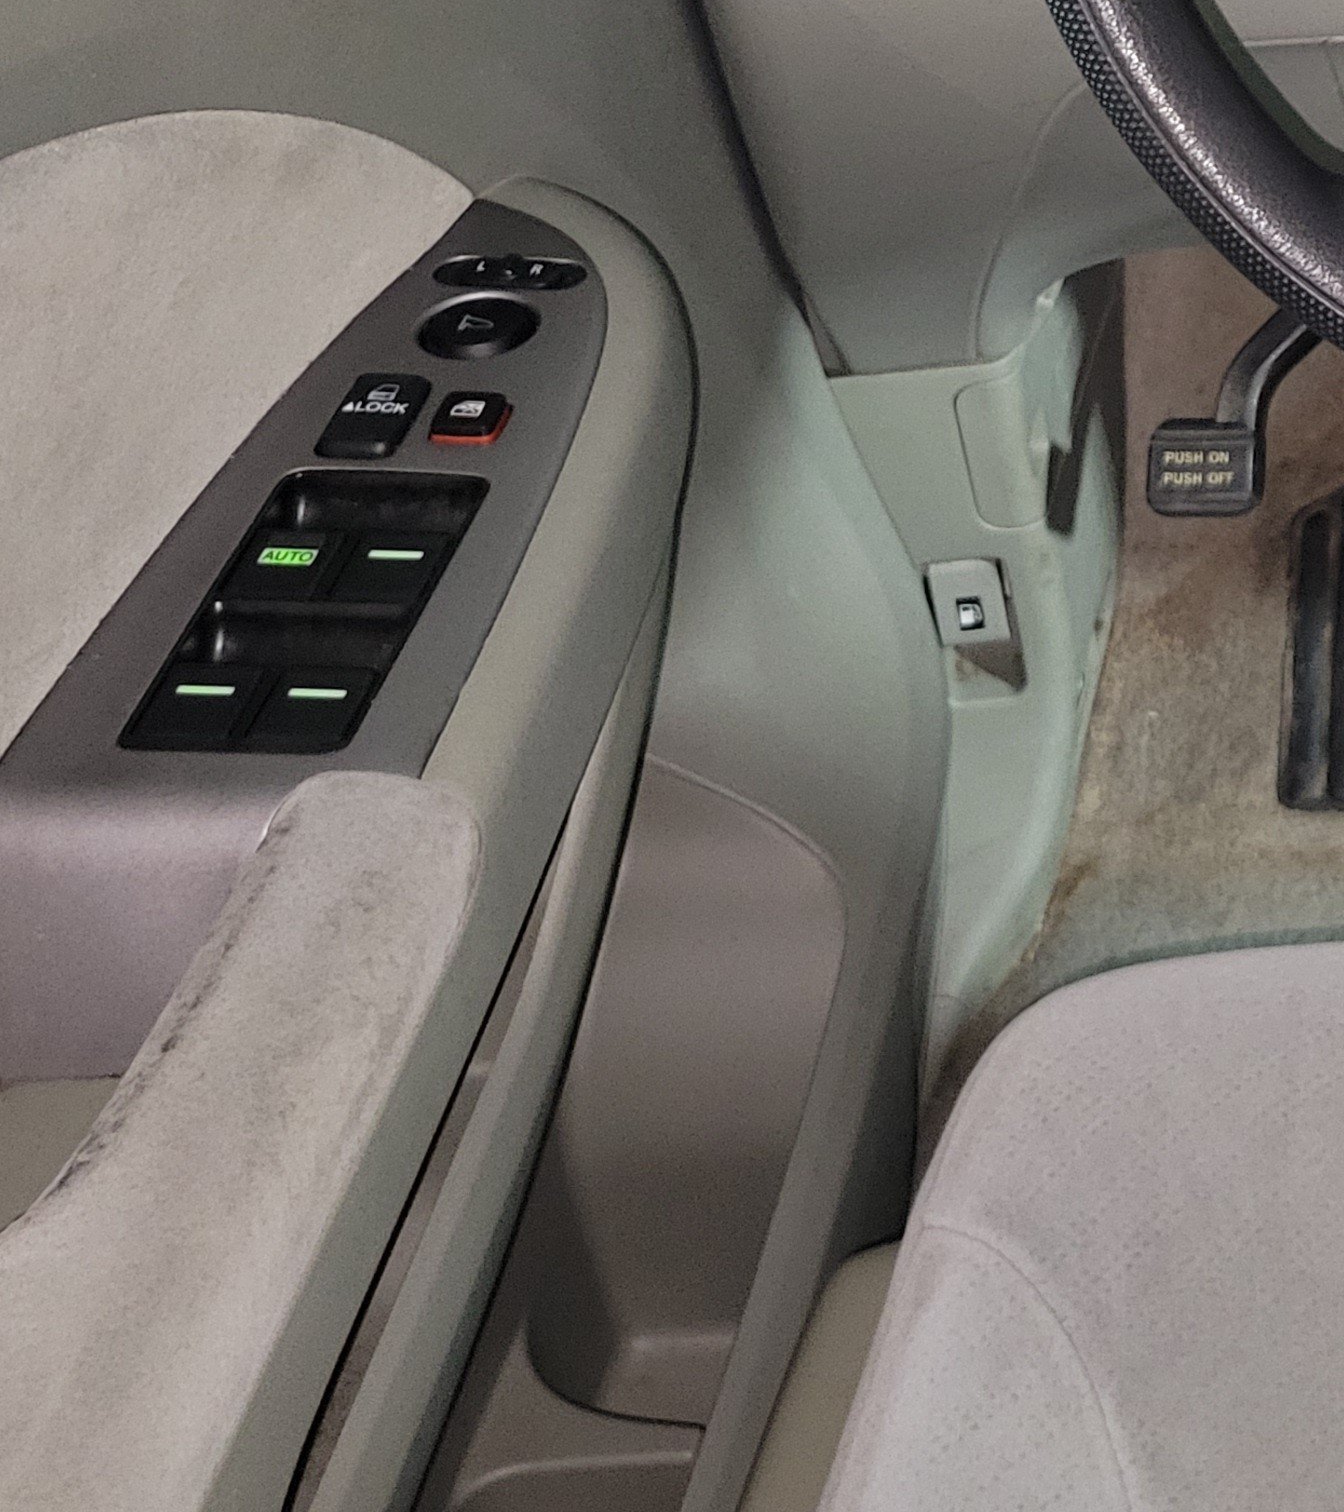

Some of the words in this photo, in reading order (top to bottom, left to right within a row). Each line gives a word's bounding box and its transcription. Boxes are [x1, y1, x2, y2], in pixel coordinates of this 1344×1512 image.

[475, 260, 485, 272] L
[529, 263, 544, 276] R
[353, 399, 409, 416] LOCK
[1163, 450, 1204, 465] PUSH
[1208, 450, 1230, 465] ON
[1163, 470, 1203, 486] PUSH
[1208, 470, 1235, 485] OFF
[260, 548, 315, 564] AUTO
